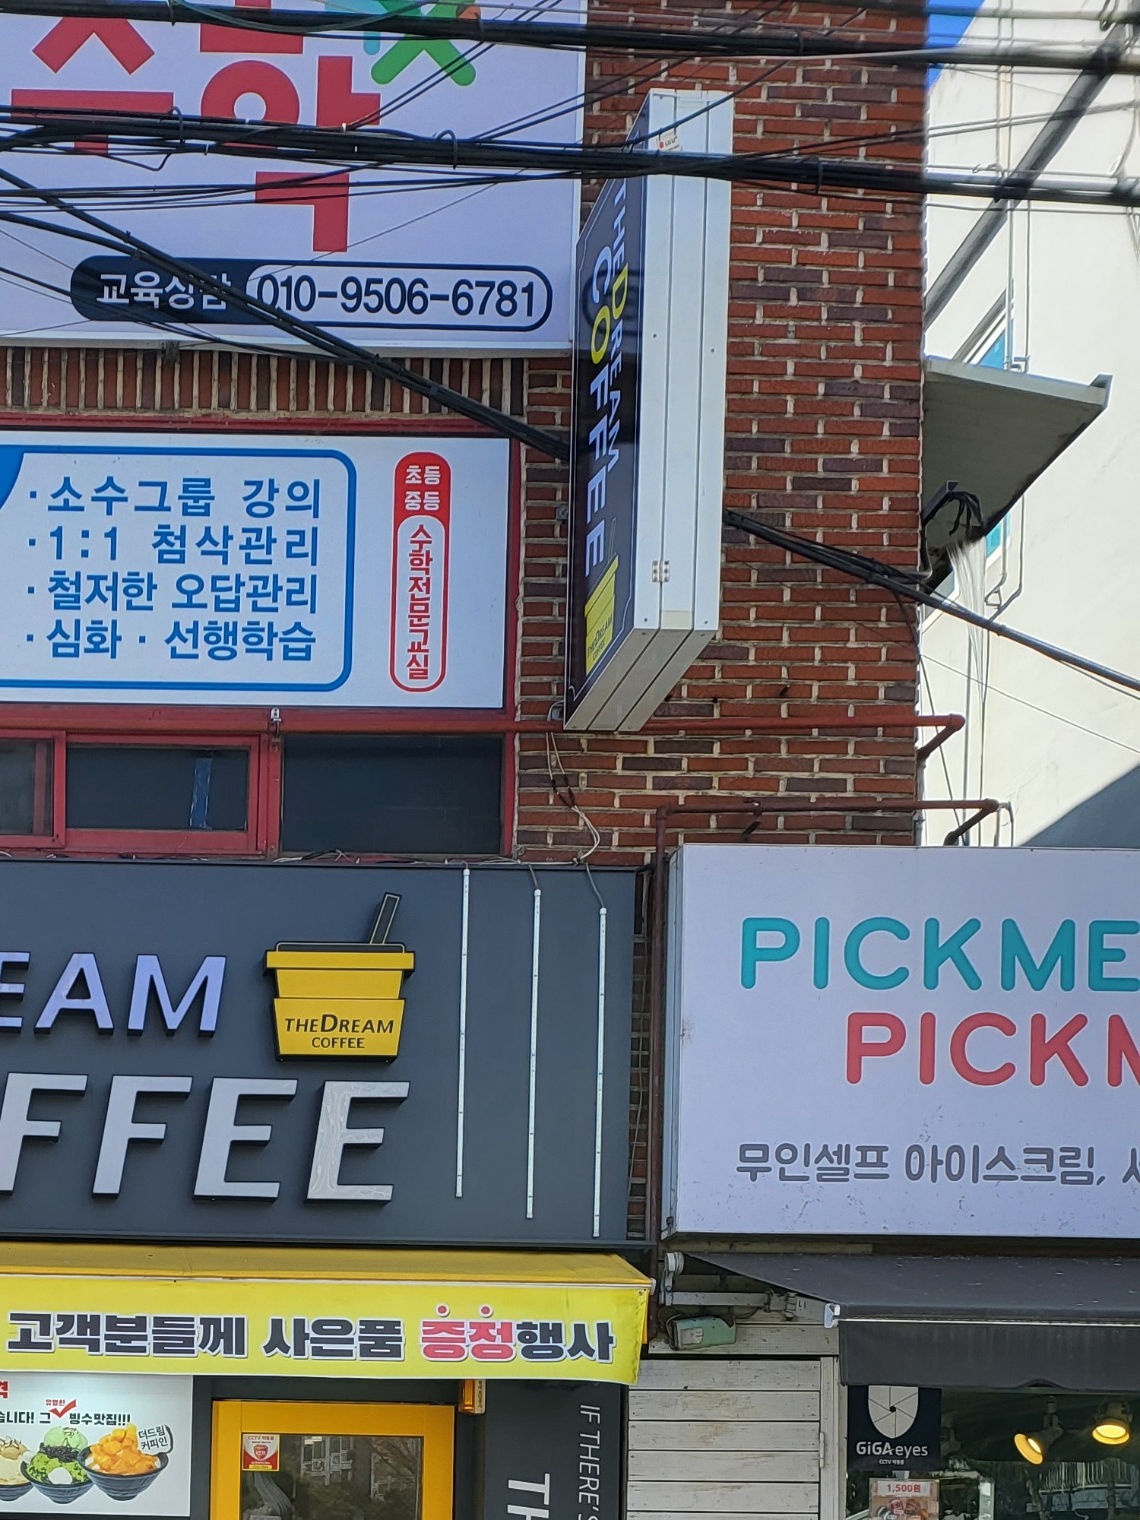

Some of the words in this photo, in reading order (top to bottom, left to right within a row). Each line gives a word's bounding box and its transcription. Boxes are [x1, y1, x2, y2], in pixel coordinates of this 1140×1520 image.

[96, 271, 229, 313] 교육상담
[255, 275, 537, 319] 010-9506-6781
[585, 243, 610, 578] COFFEE
[404, 464, 442, 487] 초등
[47, 476, 216, 517] 소수그룹
[241, 478, 322, 519] 강의
[404, 488, 442, 512] 중등
[48, 525, 120, 562] 1:1
[151, 524, 320, 567] 첨삭관리
[47, 568, 158, 612] 철저한
[172, 571, 319, 615] 오답관리
[406, 523, 434, 681] 수학전문교실
[46, 618, 122, 660] 심화
[164, 620, 317, 662] 선행학습
[310, 1036, 366, 1050] COFFEE
[736, 1142, 890, 1183] 무인셀프
[905, 1143, 1106, 1187] 아이스크림,
[7, 1309, 248, 1358] 고객분들께
[262, 1316, 405, 1361] 사은품
[419, 1317, 617, 1364] 증정행사
[39, 1412, 51, 1425] 그
[69, 1412, 132, 1426] 빙수맛집!!!
[138, 1425, 166, 1440] 더드림
[578, 1404, 601, 1425] IF
